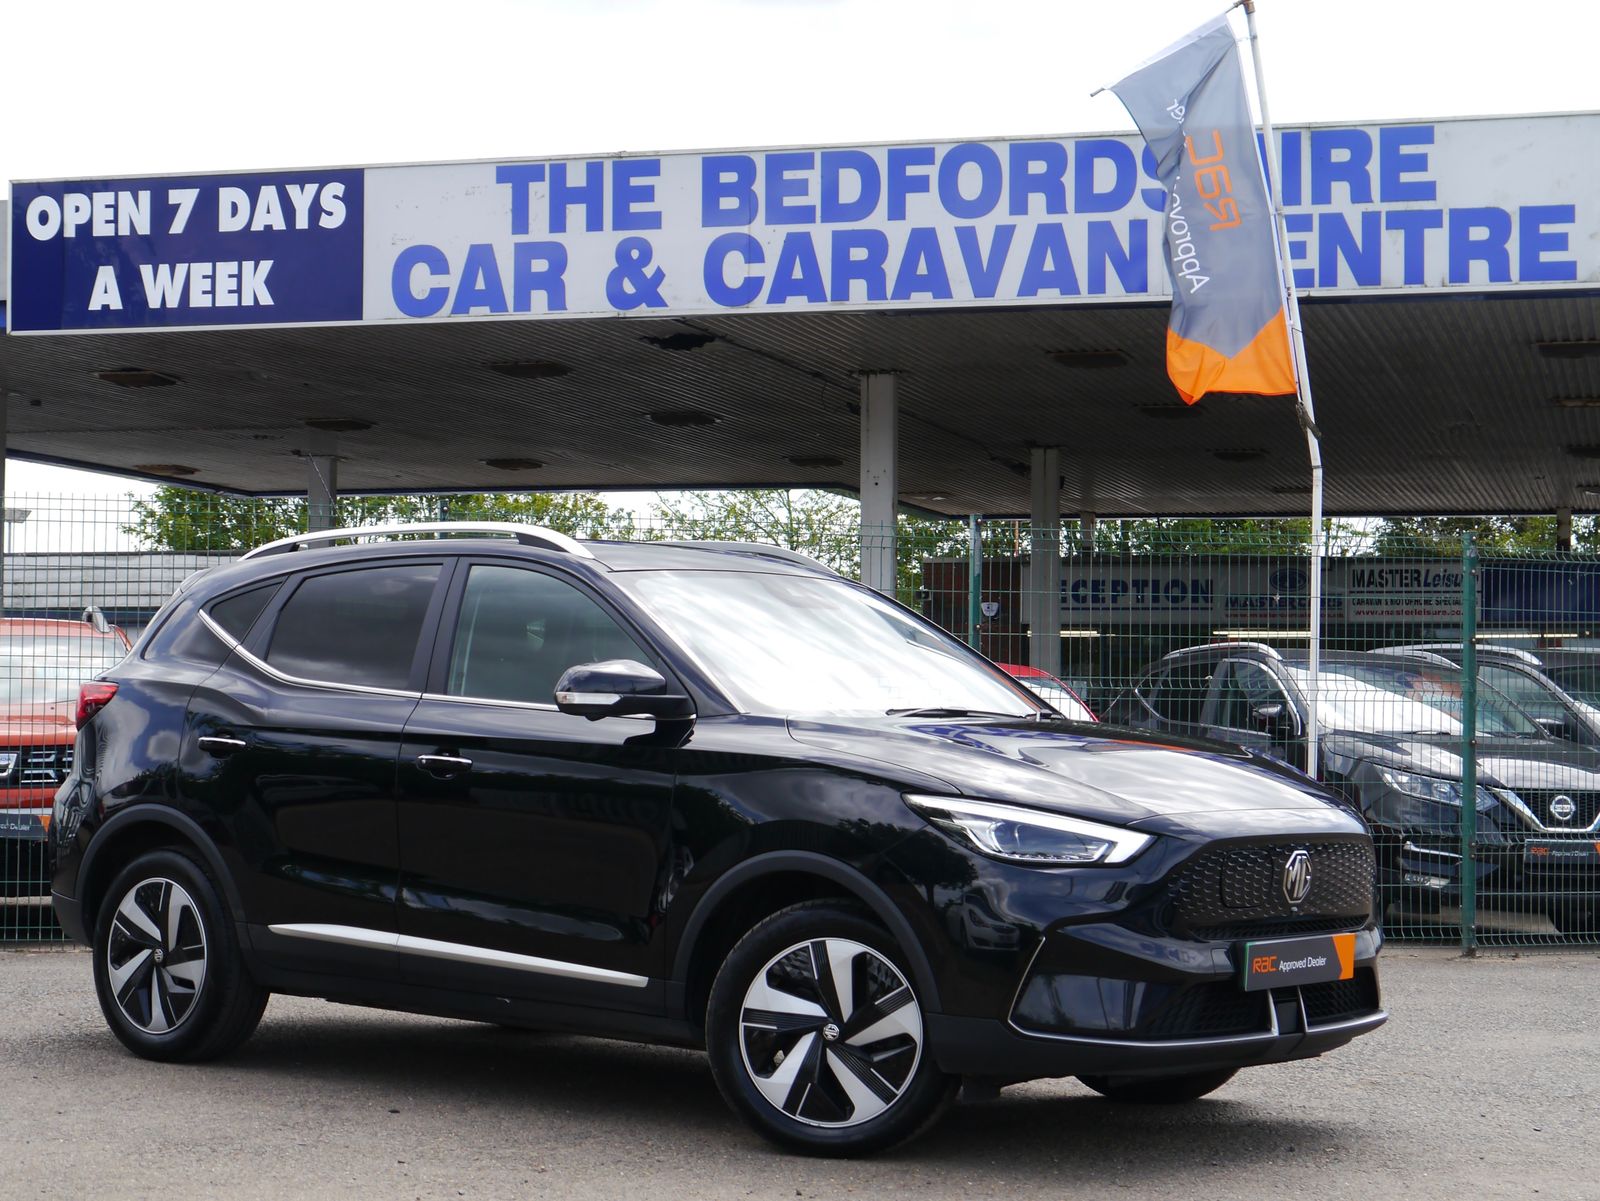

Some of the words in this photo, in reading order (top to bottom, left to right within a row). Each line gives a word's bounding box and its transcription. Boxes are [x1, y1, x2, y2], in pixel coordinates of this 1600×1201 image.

[496, 159, 662, 235] THE
[701, 125, 1437, 228] BEDFORDIRE
[26, 191, 151, 241] OPEN
[168, 188, 199, 234] 7
[219, 181, 347, 233] DAYS
[88, 265, 123, 311] A
[140, 260, 275, 309] WEEK
[391, 242, 568, 318] CAR
[605, 237, 668, 311] &
[704, 219, 1149, 307] CARAVAN
[1275, 204, 1578, 292] ENTRE
[1061, 579, 1213, 604] CEPTION
[1285, 855, 1312, 899] MG
[1278, 958, 1307, 972] Approved
[1307, 956, 1328, 968] Dealer
